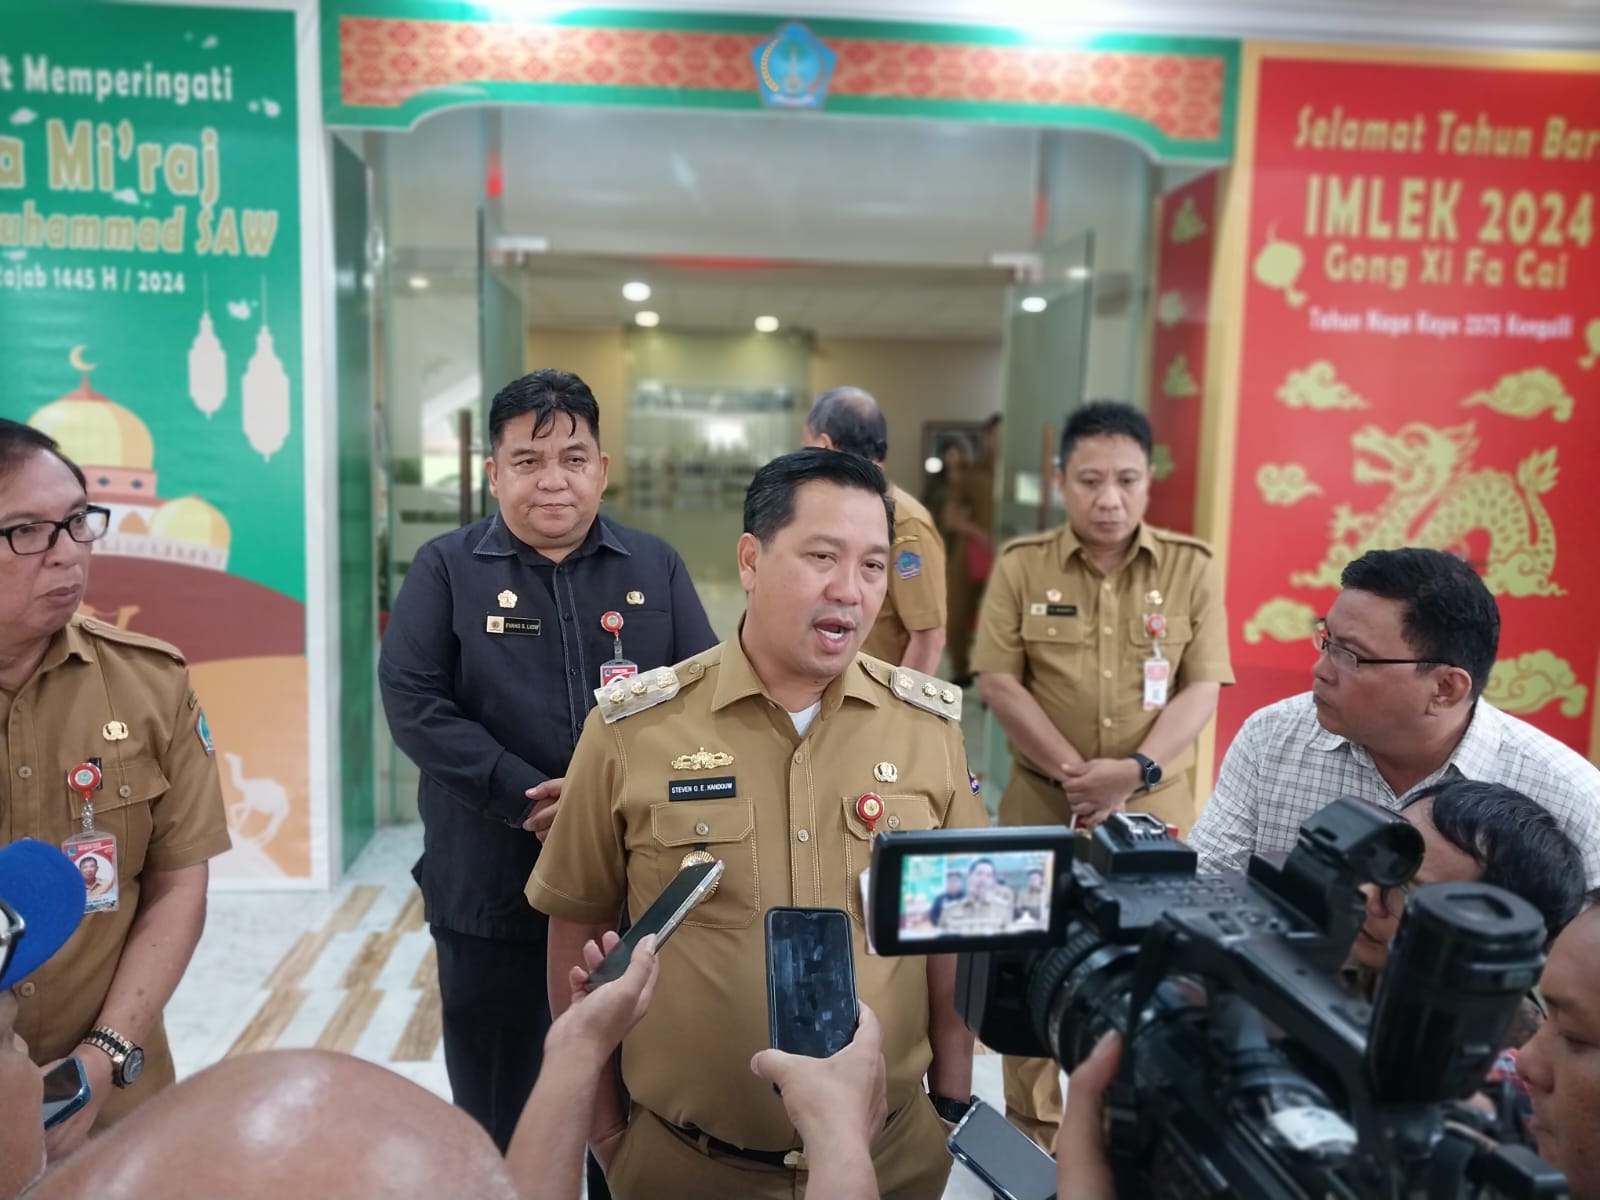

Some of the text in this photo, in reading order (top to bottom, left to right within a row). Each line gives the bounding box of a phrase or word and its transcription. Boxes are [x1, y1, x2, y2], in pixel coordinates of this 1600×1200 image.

[23, 54, 233, 105] Memperingati
[1294, 105, 1425, 151] Selamat
[1437, 110, 1533, 157] Tahun
[195, 207, 278, 257] SAW
[1305, 174, 1594, 248] IMLEK 2024
[0, 265, 185, 293] ajab 1445 H / 2024
[1323, 243, 1568, 290] Gong Xi Fa Cai
